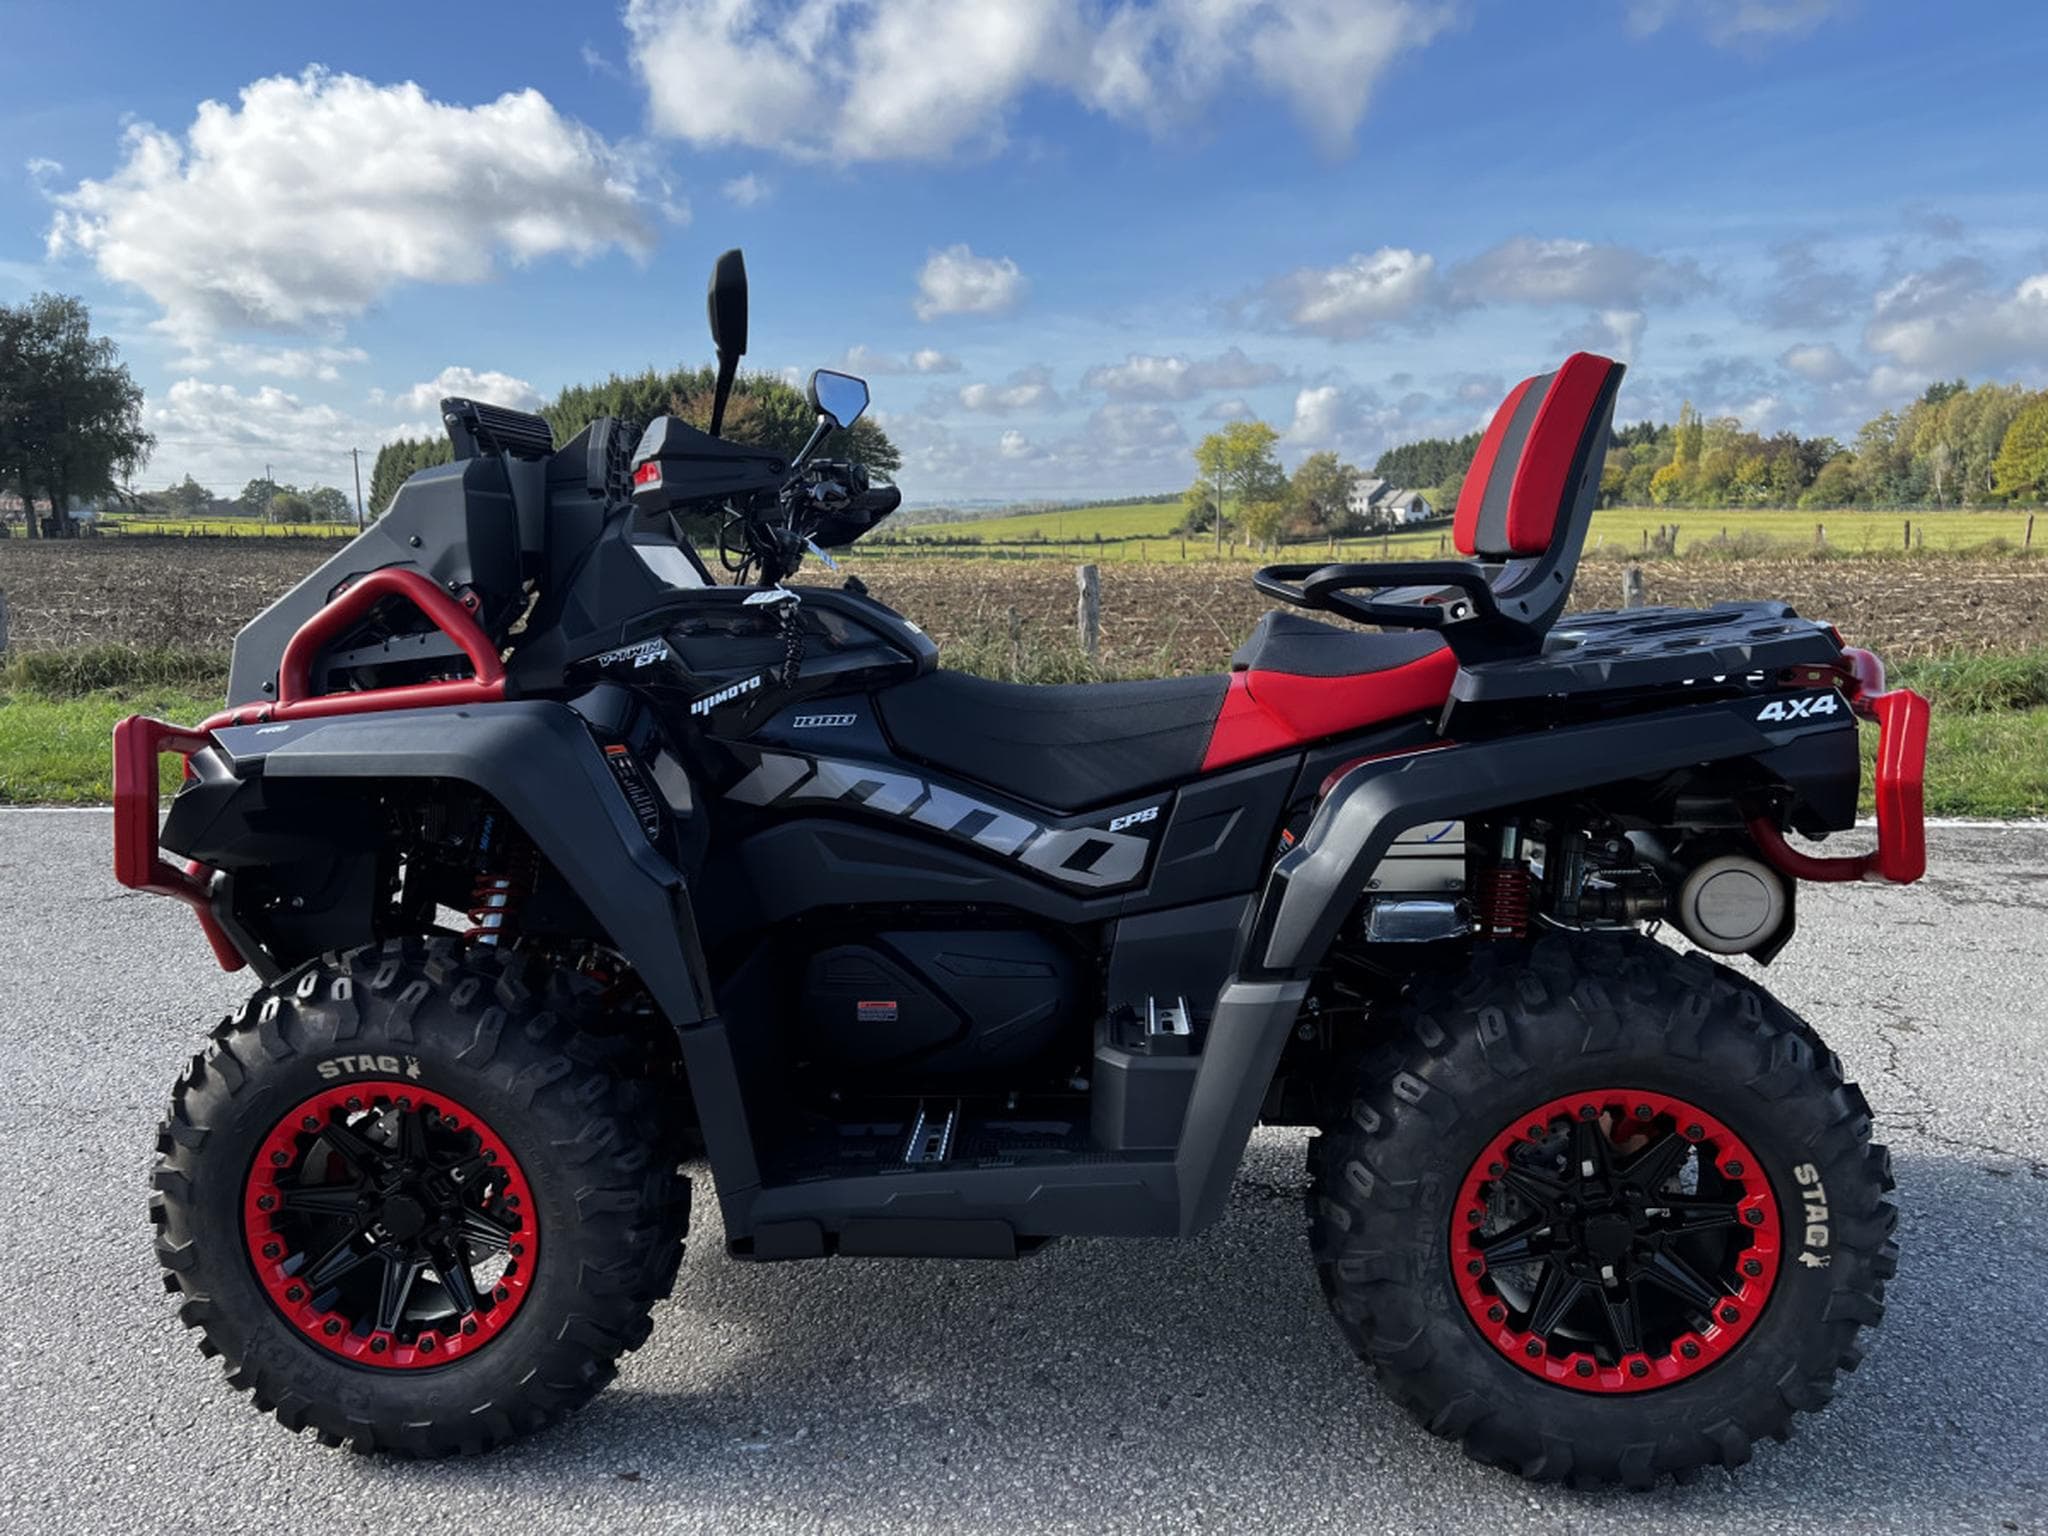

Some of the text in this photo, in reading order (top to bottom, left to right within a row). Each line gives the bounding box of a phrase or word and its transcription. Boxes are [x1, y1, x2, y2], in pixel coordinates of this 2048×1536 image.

[634, 649, 668, 669] EFI
[1108, 806, 1160, 832] EPS
[316, 1054, 401, 1079] STAG
[1793, 1163, 1829, 1248] STAG
